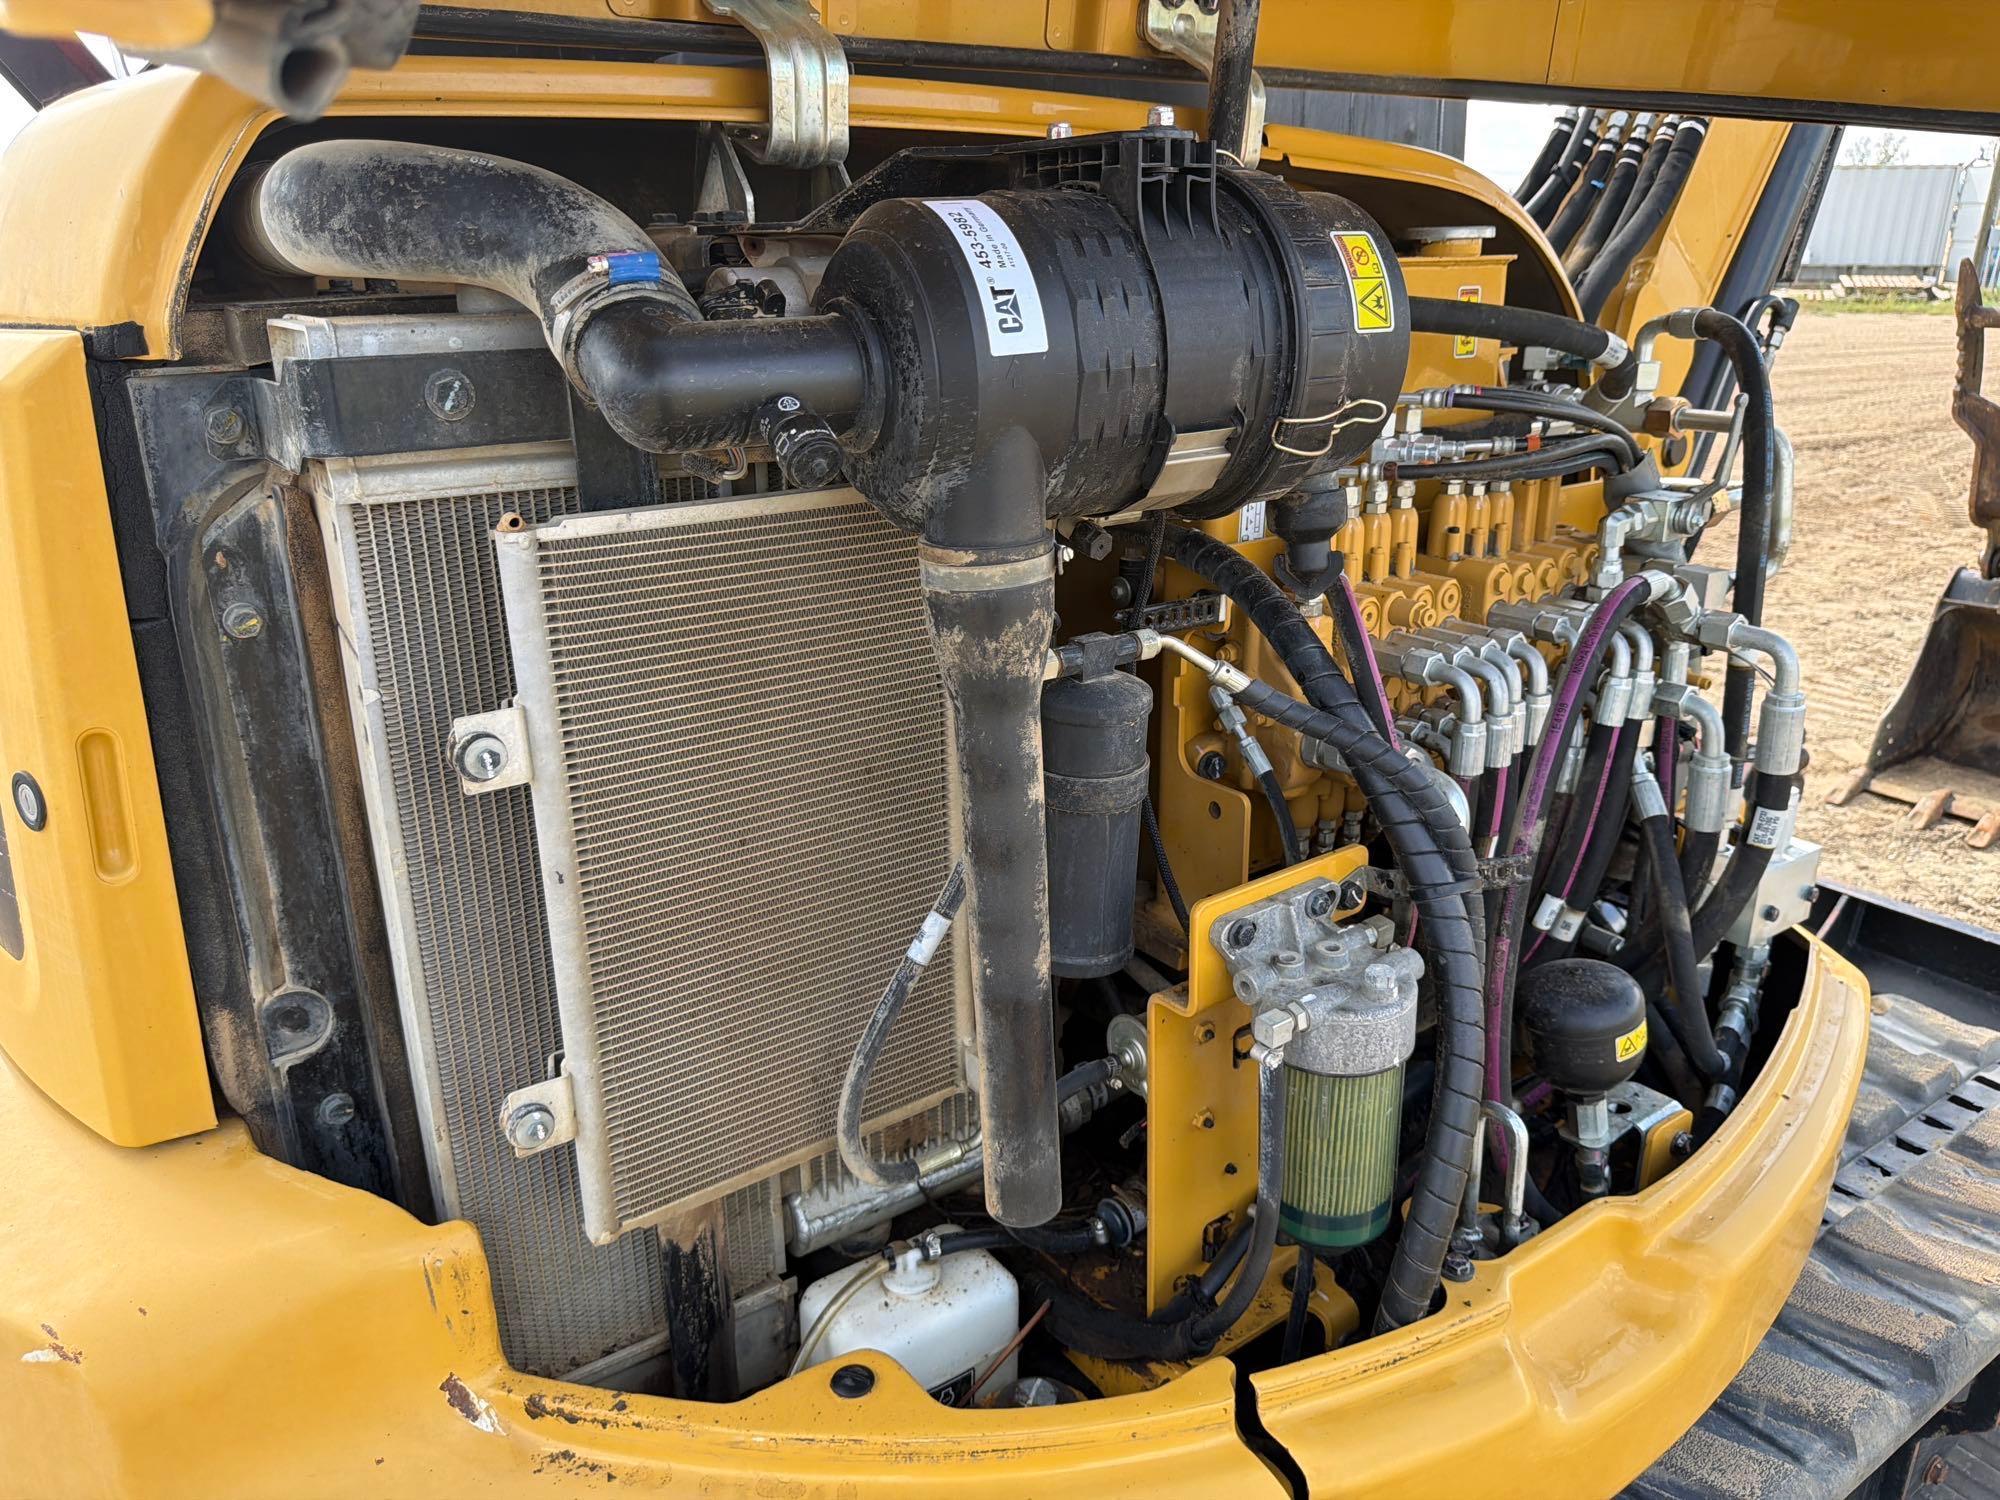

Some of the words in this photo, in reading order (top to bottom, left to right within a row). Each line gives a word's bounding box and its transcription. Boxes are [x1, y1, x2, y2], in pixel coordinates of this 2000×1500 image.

[963, 207, 988, 233] Germany
[948, 212, 992, 269] 453-5982
[985, 233, 995, 243] in
[991, 244, 1007, 269] Made
[989, 285, 1024, 334] CAT
